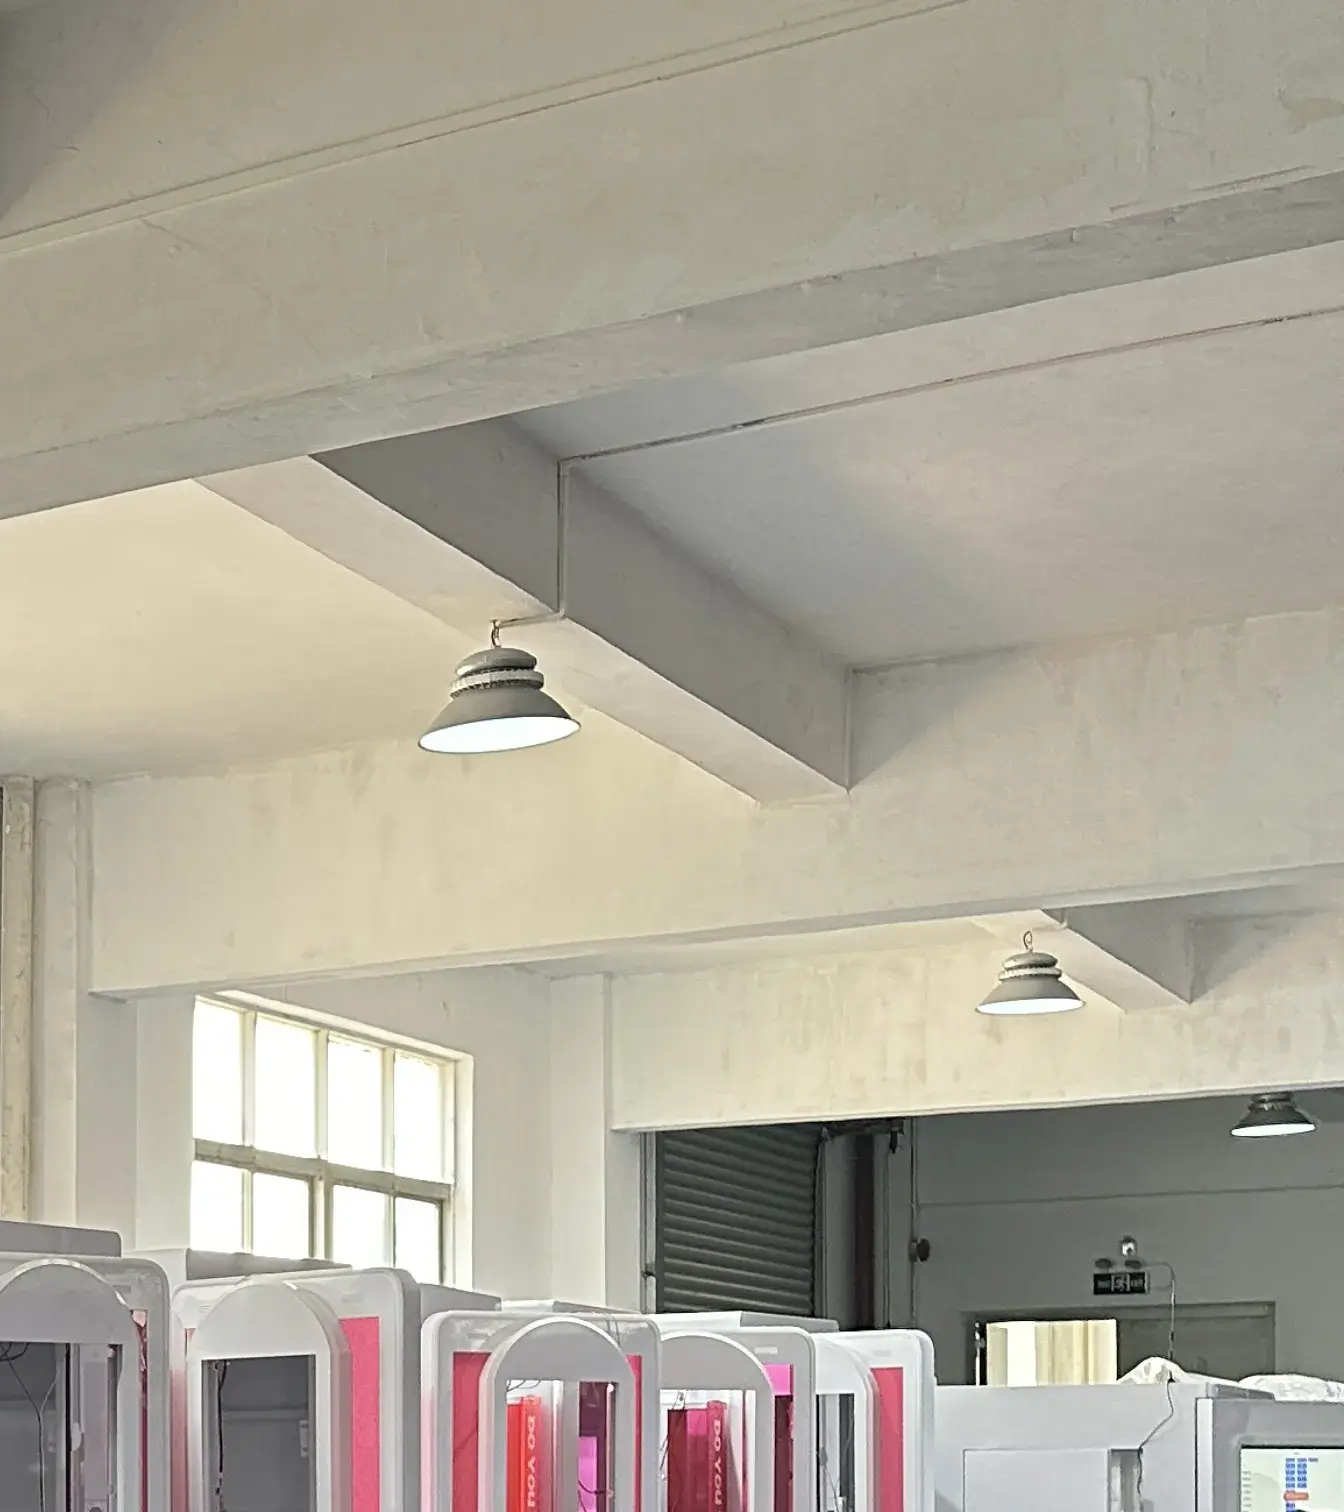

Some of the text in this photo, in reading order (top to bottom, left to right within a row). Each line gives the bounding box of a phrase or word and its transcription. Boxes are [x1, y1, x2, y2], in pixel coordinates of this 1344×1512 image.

[527, 1416, 537, 1450] DO
[713, 1419, 723, 1452] DO
[527, 1456, 536, 1508] YOU
[714, 1458, 723, 1506] YOU
